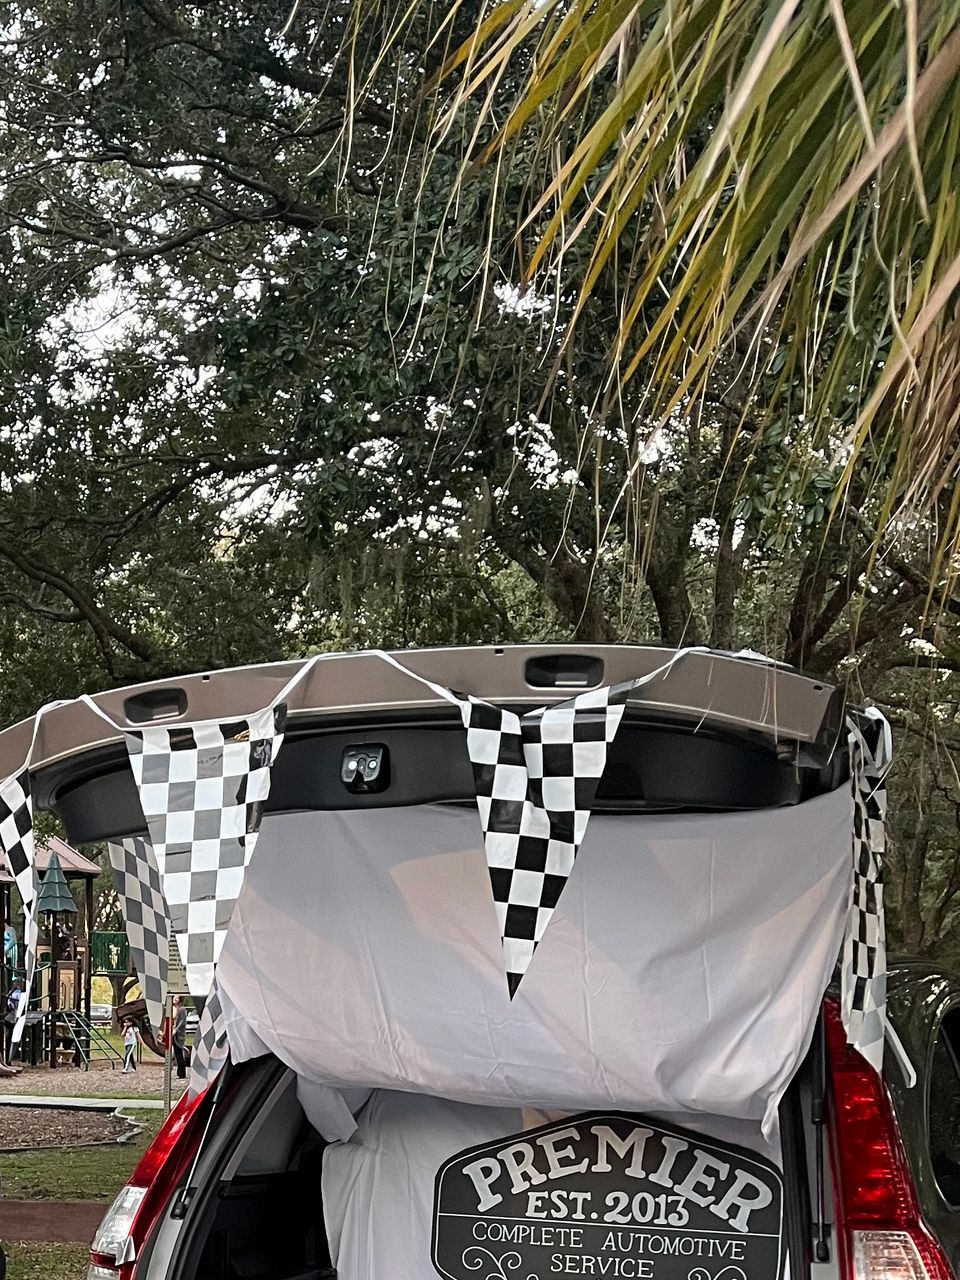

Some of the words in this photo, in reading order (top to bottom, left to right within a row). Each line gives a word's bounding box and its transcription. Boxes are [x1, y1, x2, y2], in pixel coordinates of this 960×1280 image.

[462, 1125, 774, 1233] PREMIER
[525, 1190, 598, 1220] EST.
[603, 1191, 691, 1227] 2013
[472, 1221, 584, 1248] COMPLETE
[601, 1232, 748, 1260] AUTOMOTIVE
[550, 1253, 655, 1279] SERVICE
